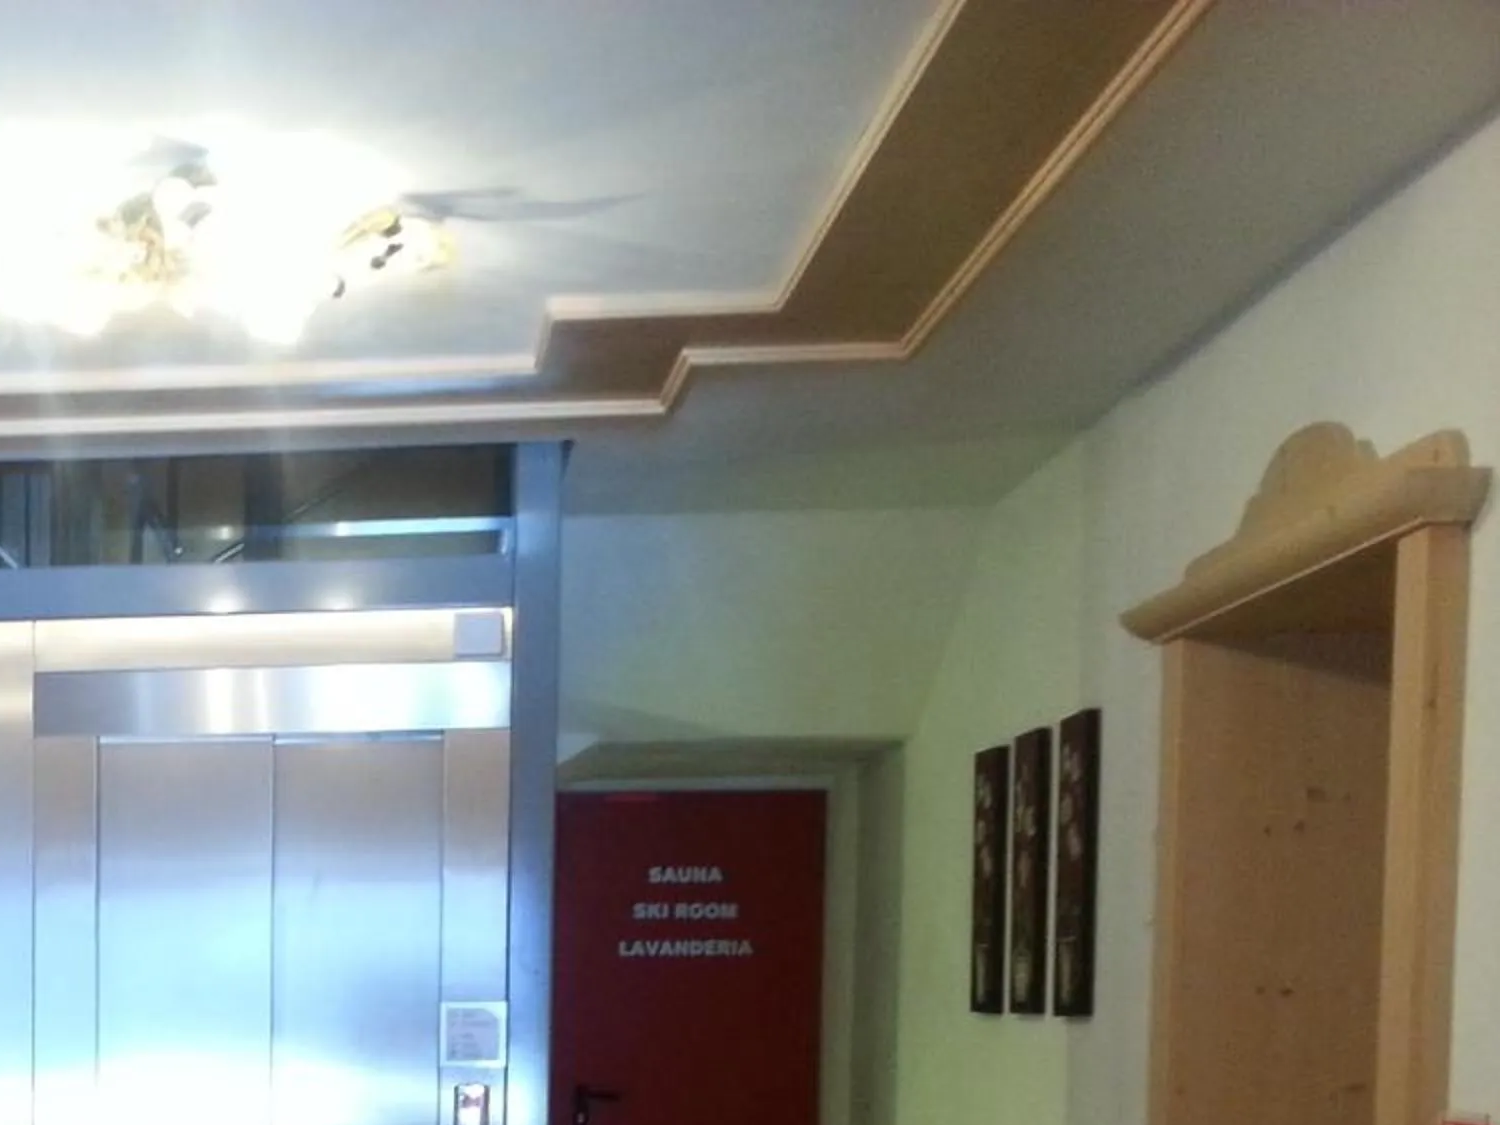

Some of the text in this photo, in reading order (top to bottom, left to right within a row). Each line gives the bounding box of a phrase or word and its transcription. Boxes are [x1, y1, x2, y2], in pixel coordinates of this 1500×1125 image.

[648, 866, 723, 883] SAUNA
[632, 902, 739, 919] SKI ROOM
[618, 940, 753, 957] LAVANDERIA
